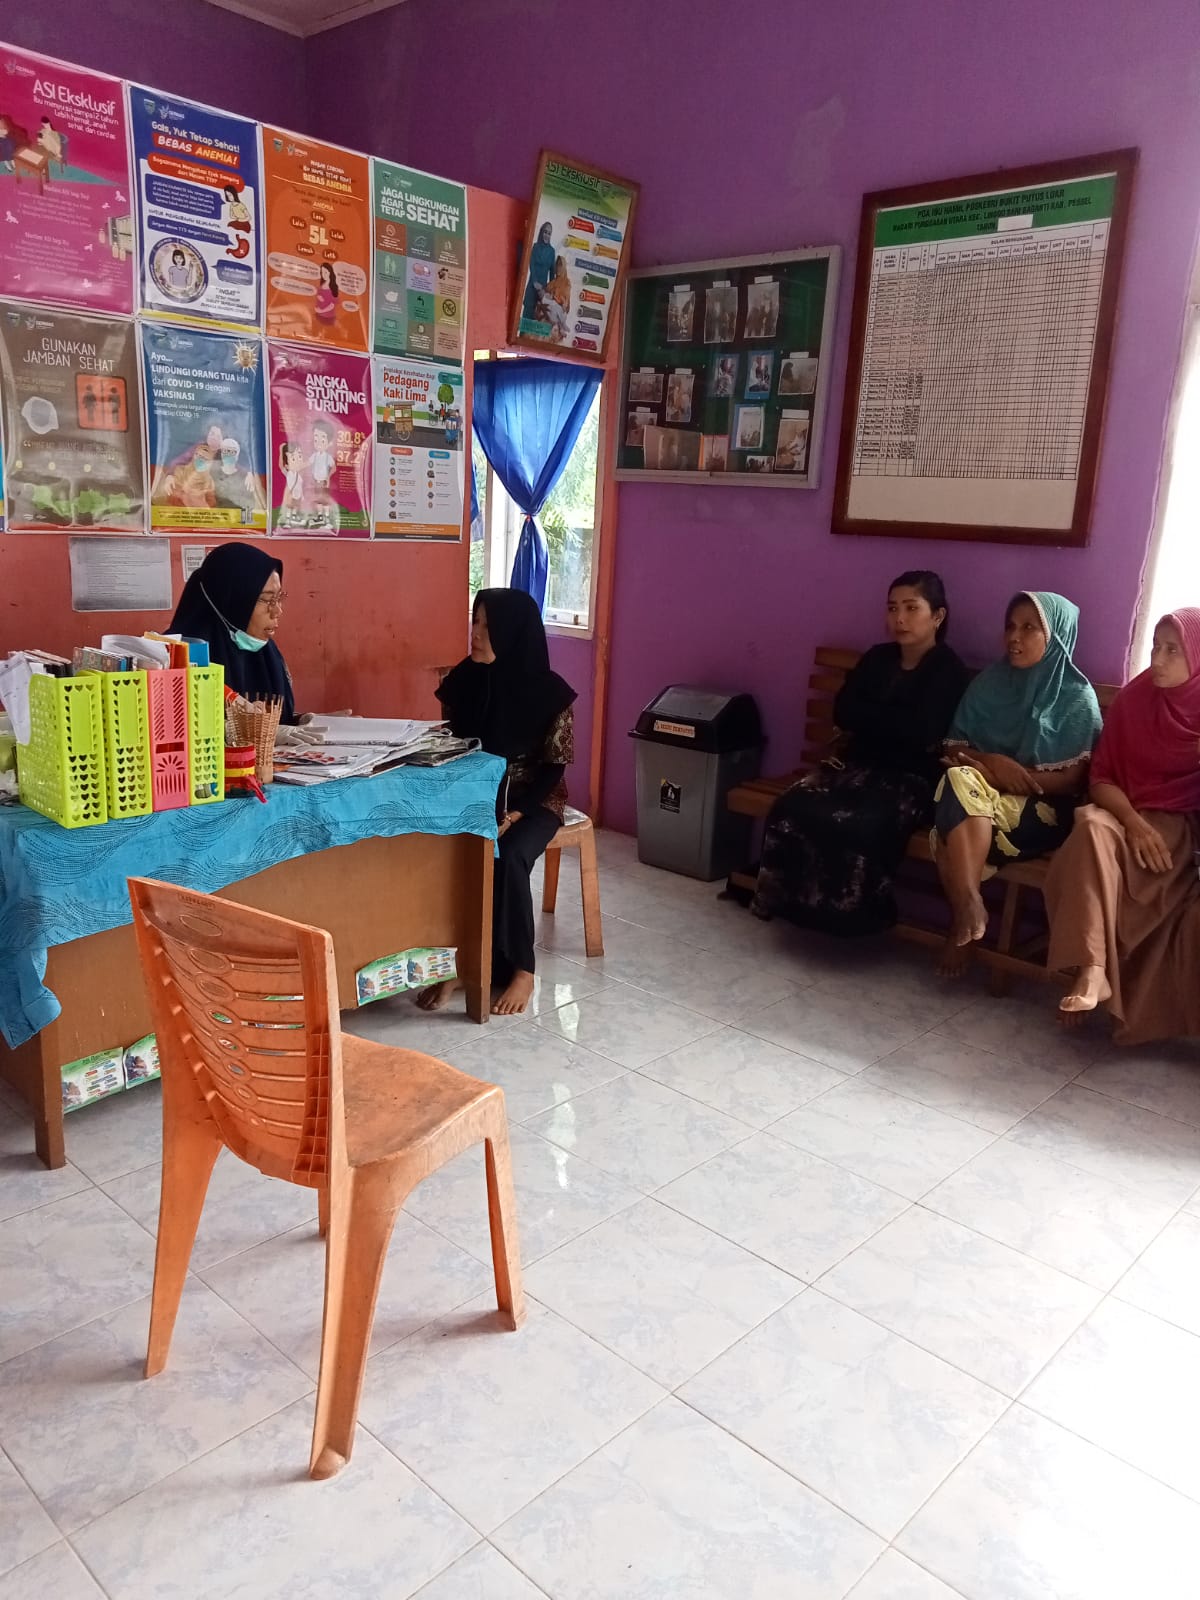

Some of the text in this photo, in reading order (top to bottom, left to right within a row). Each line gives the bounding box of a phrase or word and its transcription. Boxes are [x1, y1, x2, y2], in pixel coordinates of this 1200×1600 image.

[33, 79, 116, 116] ASI Eksklusif
[173, 126, 188, 137] Yuk
[189, 131, 214, 146] Tetap
[214, 139, 241, 153] Sehat!
[158, 136, 239, 166] BEBAS ANEMIA!
[380, 186, 460, 216] JAGA LINGKUNGAN
[380, 196, 404, 210] AGAR
[380, 204, 406, 218] TETAP
[406, 203, 460, 232] SEHAT
[308, 224, 329, 246] 5L
[41, 337, 96, 357] GUNAKAN
[23, 349, 115, 373] JAMBAN SEHAT
[151, 364, 191, 377] LINDUNGI
[191, 368, 220, 381] ORANG
[220, 373, 236, 382] TUA
[305, 373, 349, 391] ANGKA
[383, 372, 430, 392] Pedagang
[167, 378, 205, 390] COVID-19
[152, 388, 195, 401] VAKSINASI
[306, 385, 367, 405] STUNTING
[383, 386, 427, 403] Kaki Lima
[305, 397, 349, 415] TURUN
